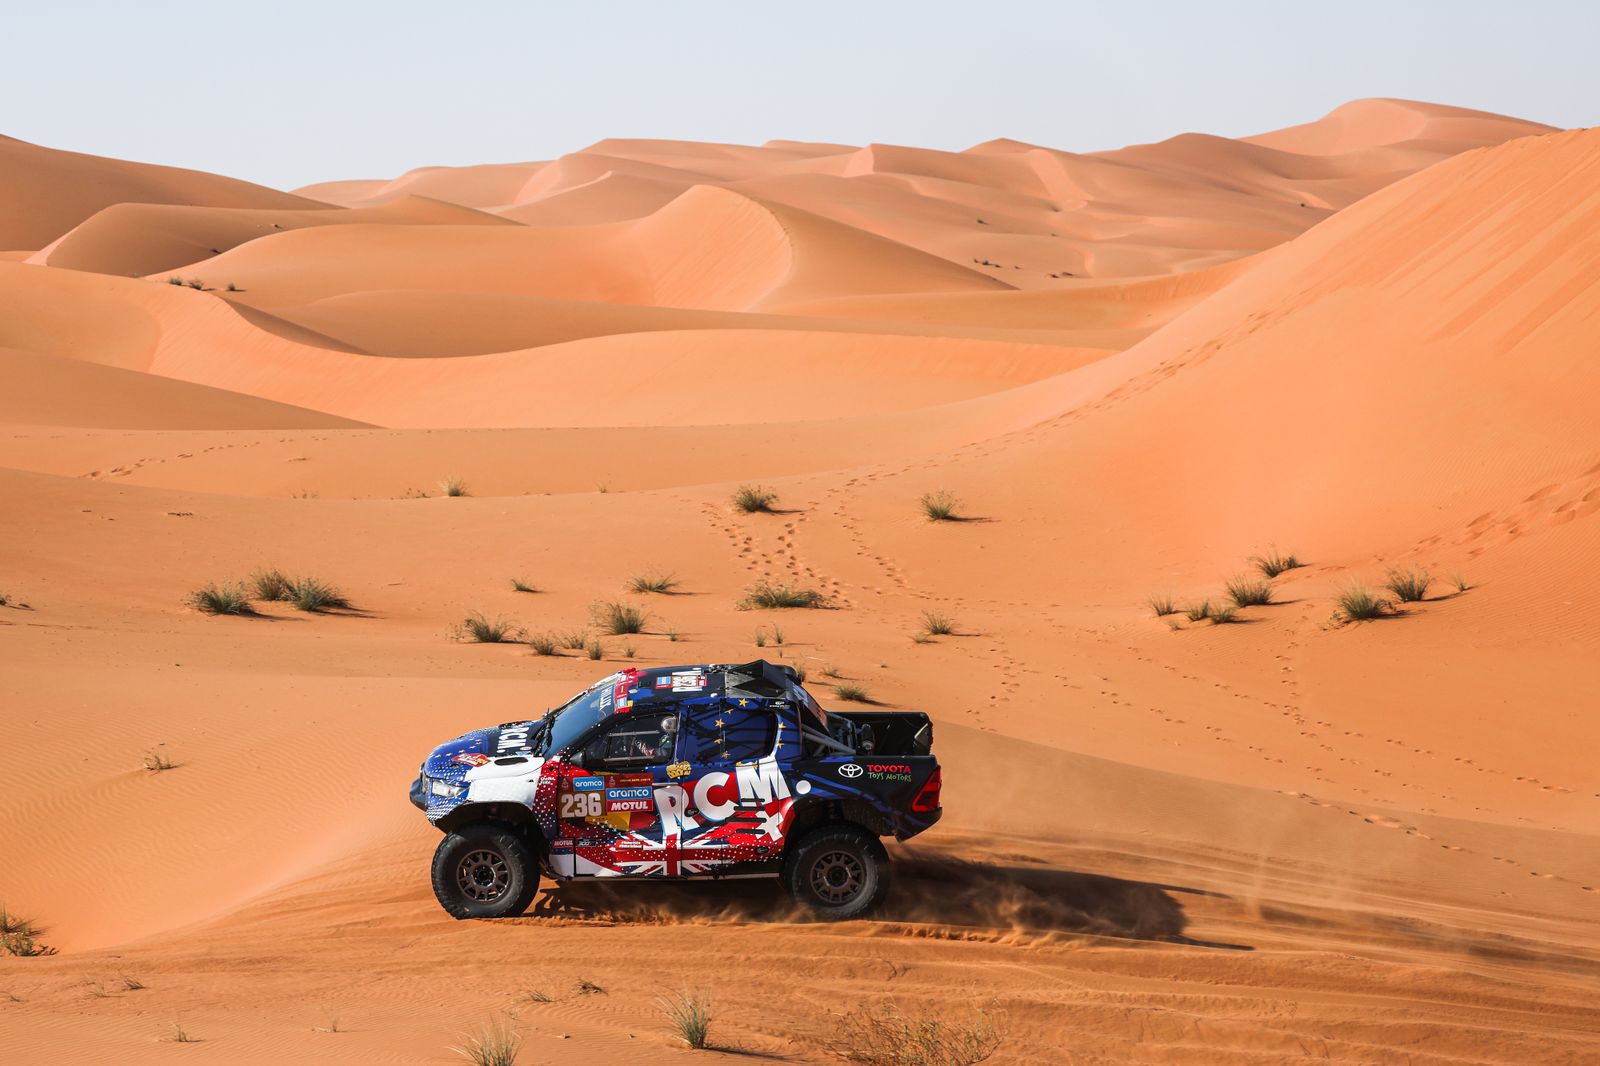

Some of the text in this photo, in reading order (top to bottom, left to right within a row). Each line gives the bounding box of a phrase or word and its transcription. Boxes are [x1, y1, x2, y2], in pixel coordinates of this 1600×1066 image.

[867, 765, 911, 773] TOYOTA
[609, 788, 649, 798] aramco
[561, 793, 602, 817] 236
[611, 801, 648, 811] MOTUL
